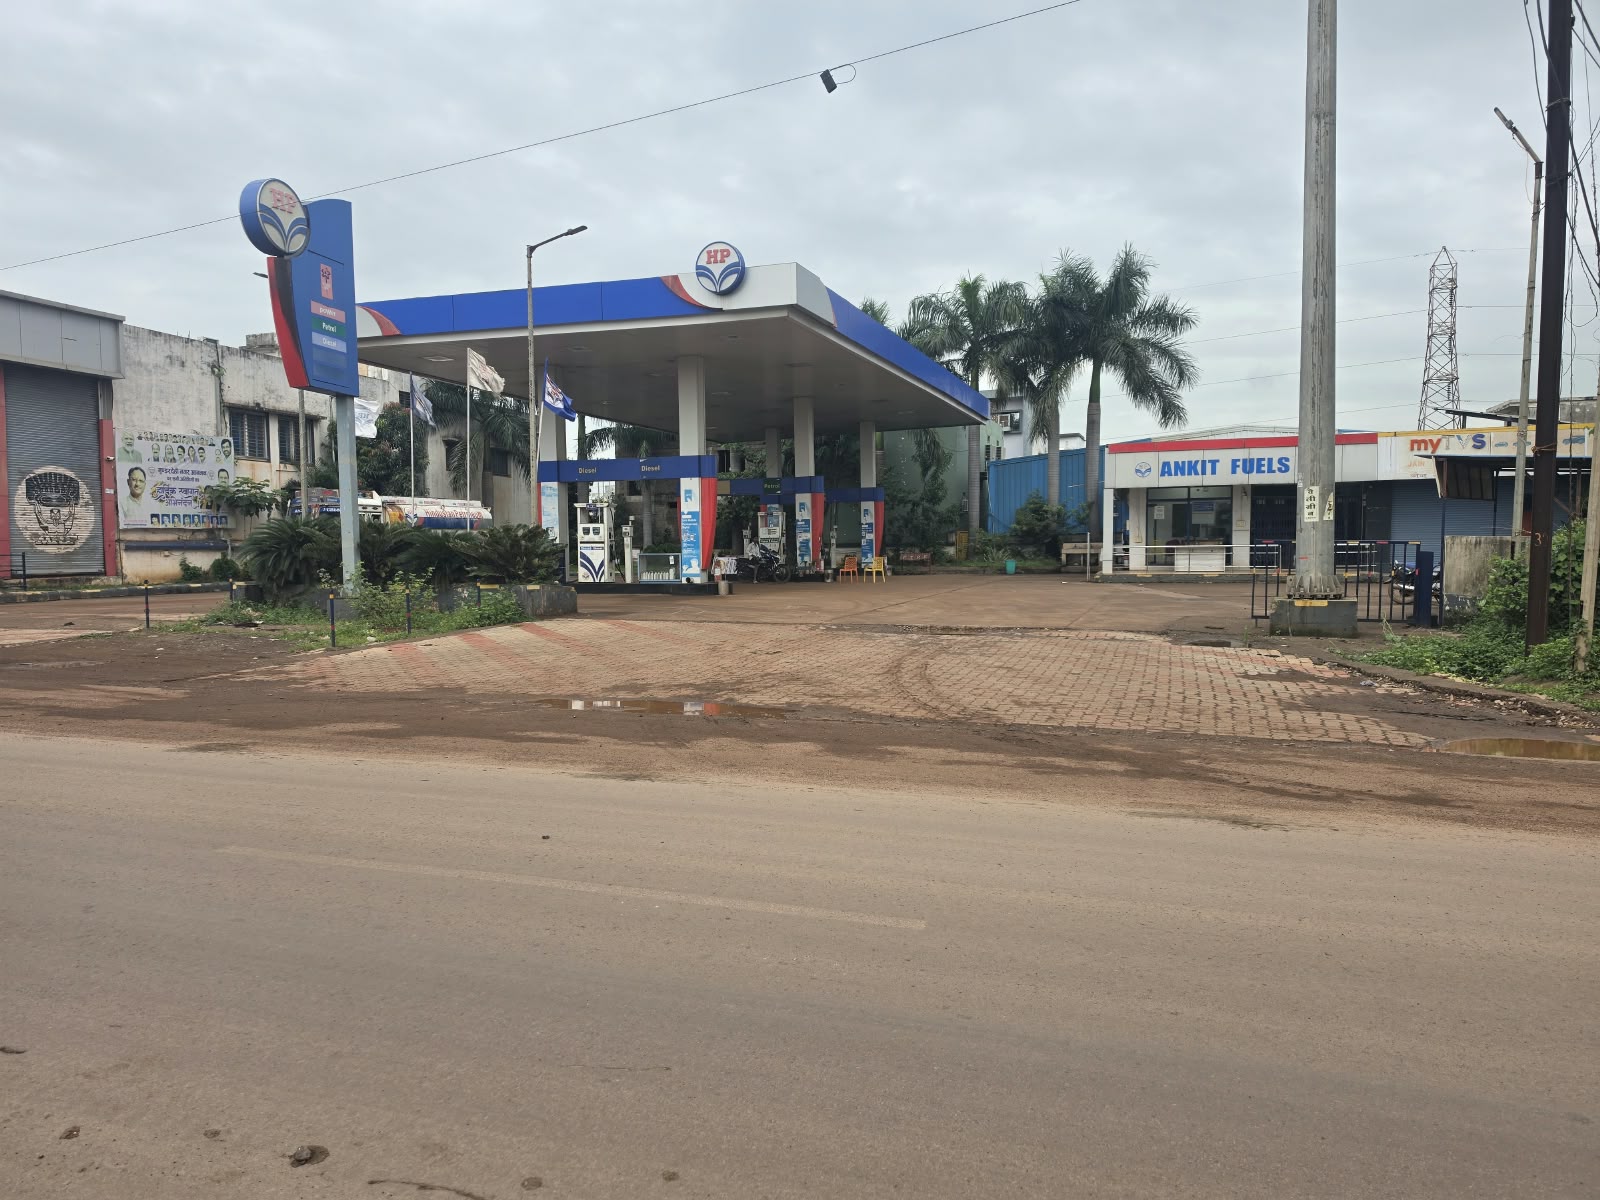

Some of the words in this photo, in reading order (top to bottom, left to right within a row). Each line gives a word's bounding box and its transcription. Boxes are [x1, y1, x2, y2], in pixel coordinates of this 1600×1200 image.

[269, 187, 297, 214] HP
[705, 248, 731, 265] HP
[322, 322, 337, 333] Petrol
[322, 337, 337, 348] Diesel
[1159, 459, 1220, 477] ANKIT
[1231, 457, 1290, 475] FUELS
